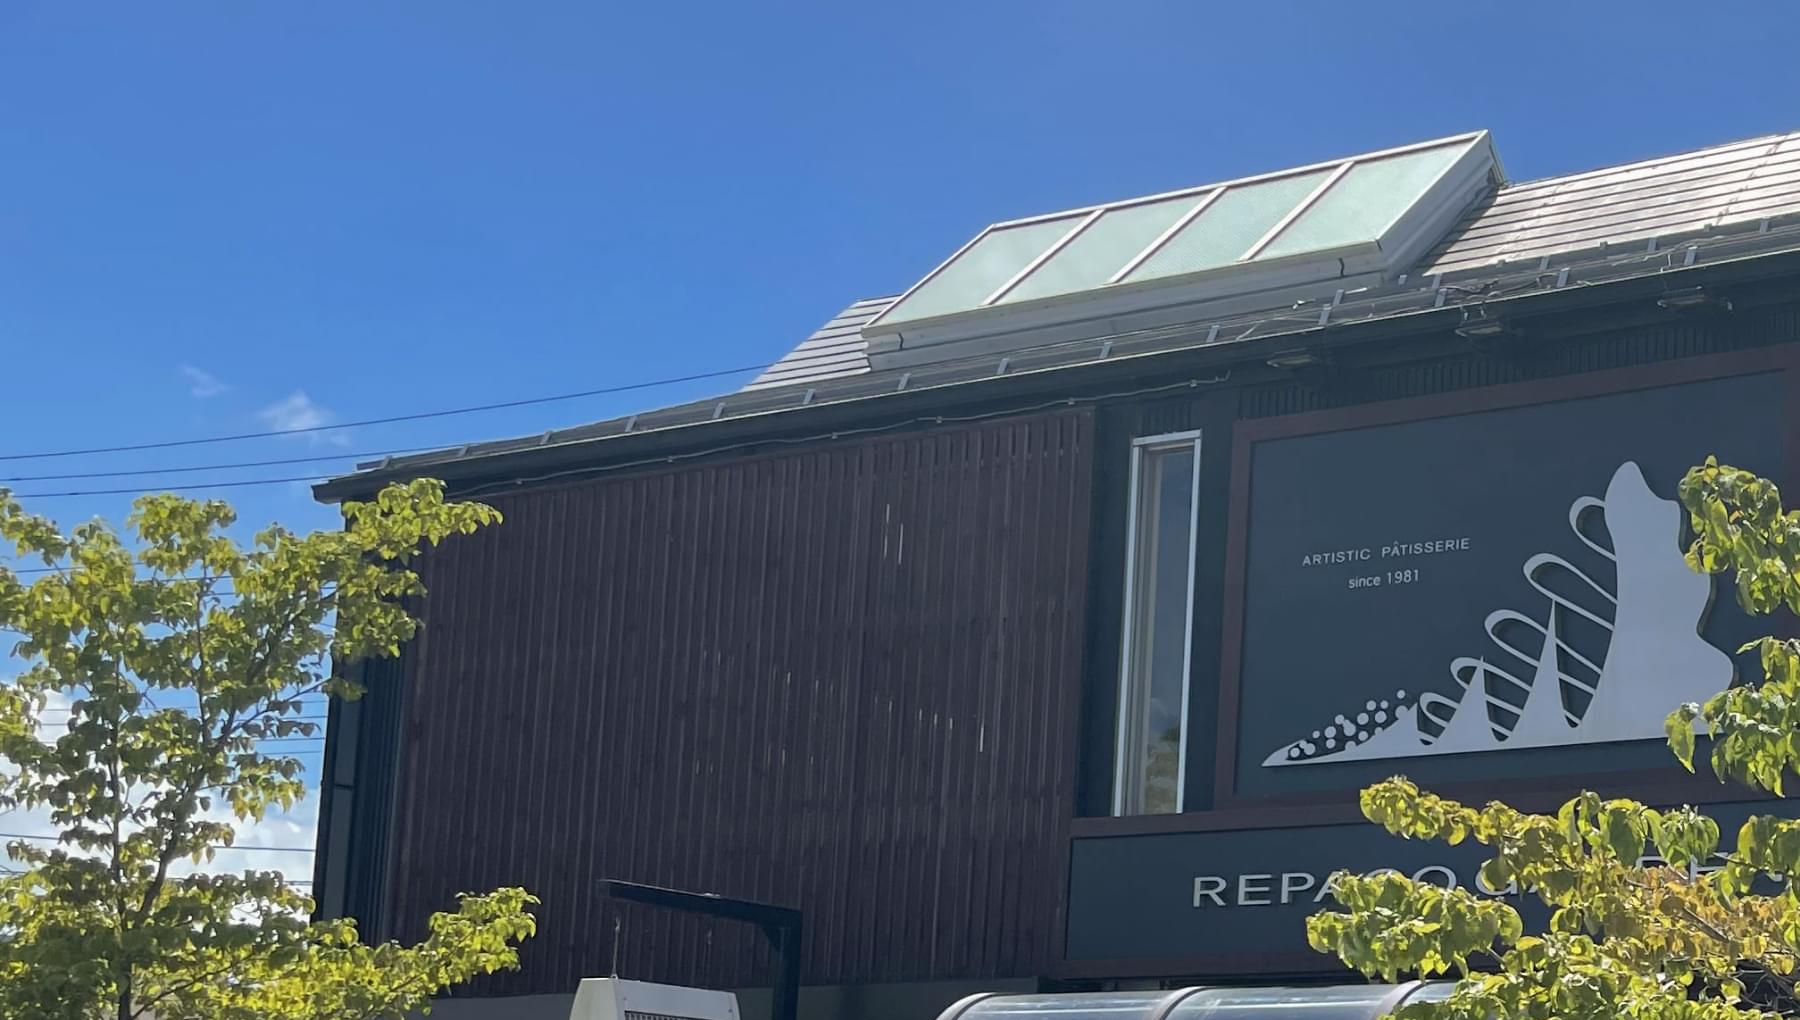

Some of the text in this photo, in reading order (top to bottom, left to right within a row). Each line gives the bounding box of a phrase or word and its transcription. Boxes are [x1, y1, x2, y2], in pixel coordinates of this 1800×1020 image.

[1302, 538, 1471, 567] ARTISTIC PÂTISSERIE
[1348, 569, 1419, 589] since 1981
[1191, 864, 1458, 908] REPO
